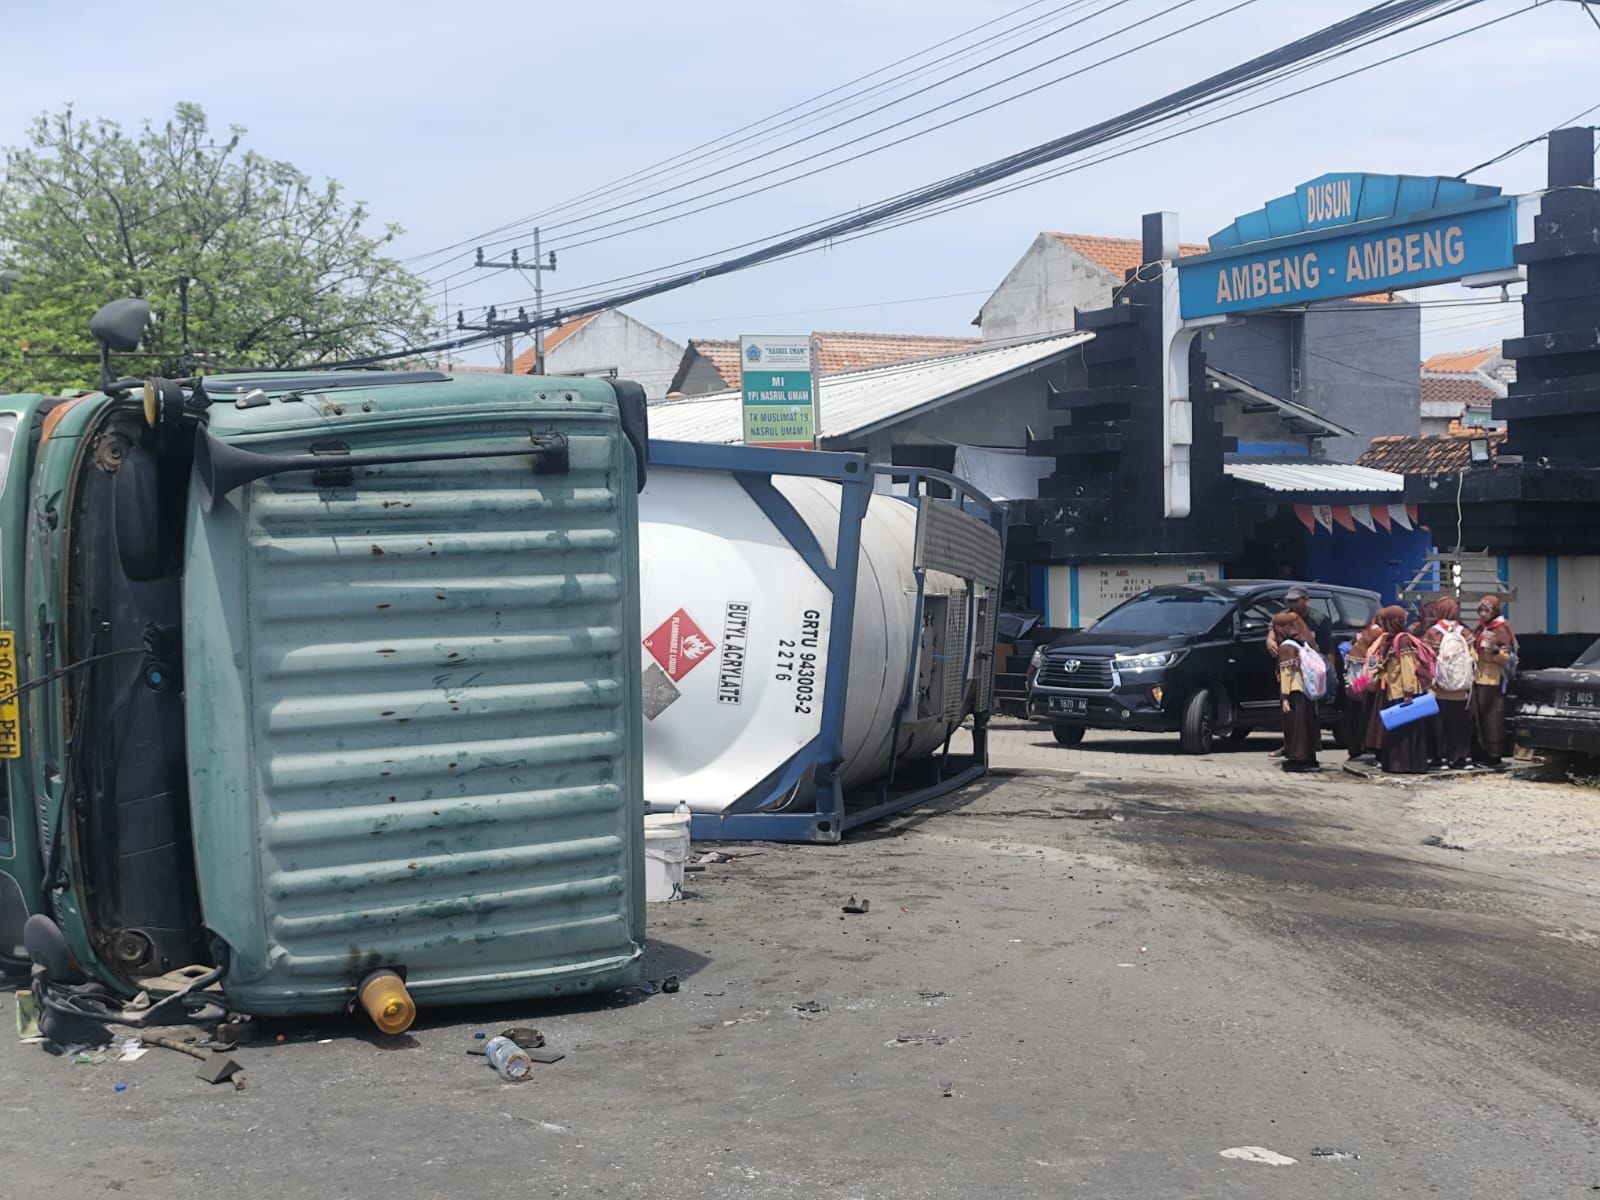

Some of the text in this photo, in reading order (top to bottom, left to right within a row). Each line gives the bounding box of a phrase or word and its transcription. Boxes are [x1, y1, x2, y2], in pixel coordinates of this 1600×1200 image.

[1307, 179, 1351, 224] DUSUN
[1217, 252, 1320, 304] AMBENG
[1346, 226, 1465, 283] AMBENG
[772, 376, 785, 386] MI
[747, 391, 809, 401] YPI NASRUL UMAM
[749, 412, 809, 422] TK MUSLIMAT 19
[750, 426, 778, 436] NASRUL
[780, 426, 802, 436] UMAM
[644, 639, 653, 647] 3
[668, 616, 680, 675] FLAMMABLE LIQUID
[719, 603, 748, 703] BUTYL ACRYLATE
[794, 609, 820, 715] GRTU 943003-2
